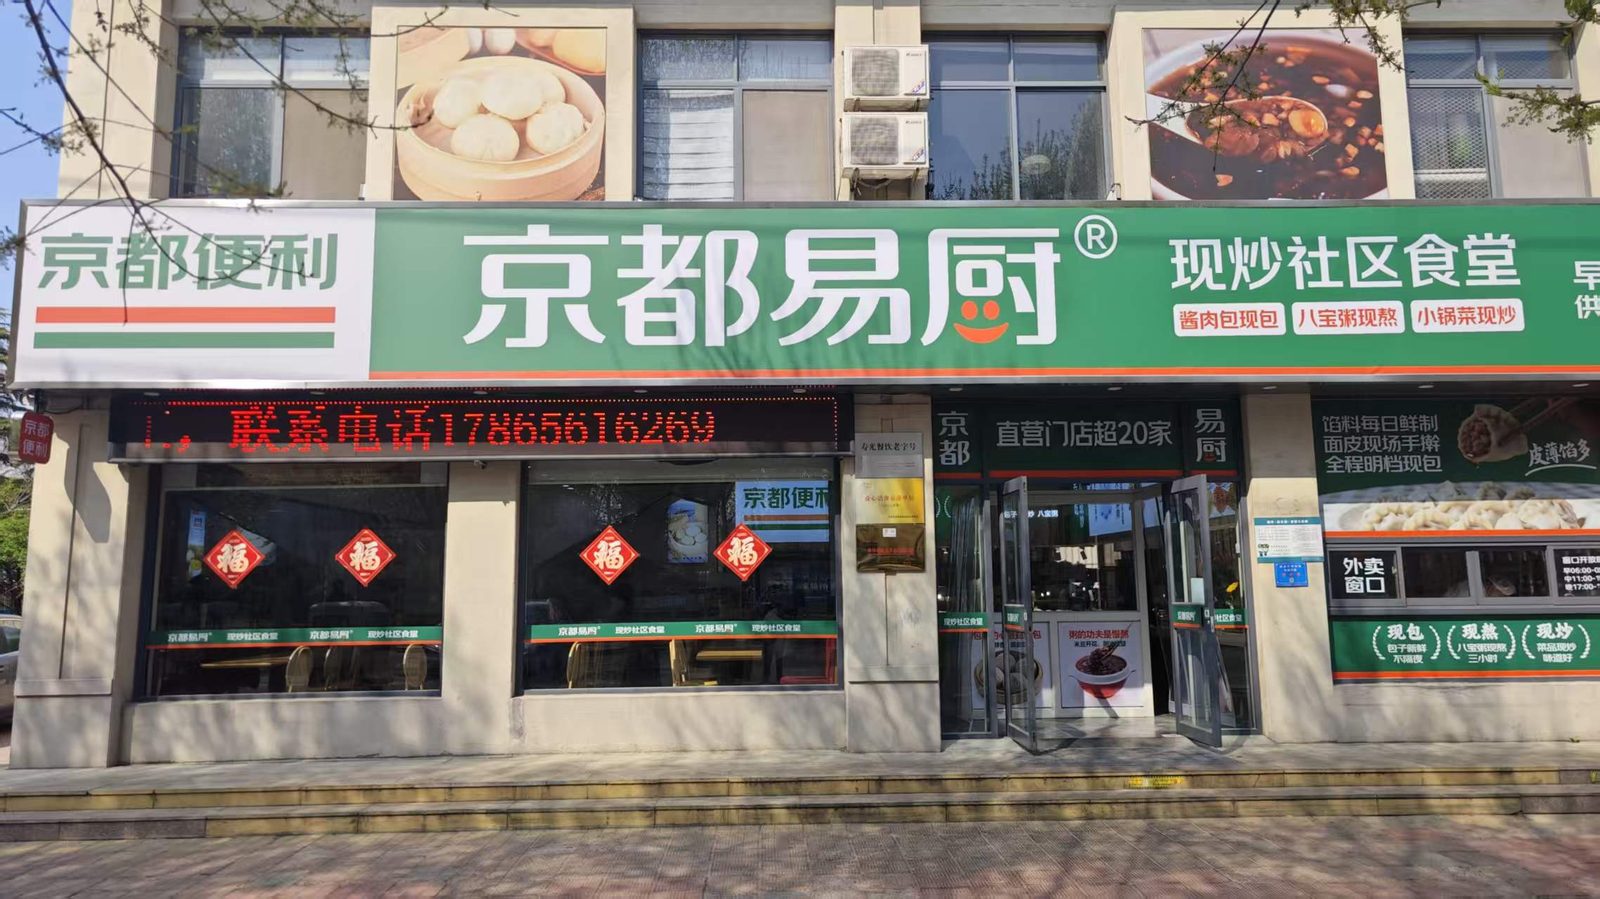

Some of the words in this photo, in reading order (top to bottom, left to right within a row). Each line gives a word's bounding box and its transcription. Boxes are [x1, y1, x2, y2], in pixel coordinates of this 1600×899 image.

[37, 232, 339, 291] 京都便利
[1168, 232, 1521, 292] 现炒社区食堂
[463, 223, 1062, 348] 京都易厨
[1573, 261, 1600, 291] 早
[1298, 308, 1399, 329] 八宝粥现熬
[1416, 305, 1517, 327] 小锅菜现炒
[1574, 294, 1600, 319] 供
[1178, 309, 1280, 331] 酱肉包现包
[995, 420, 1172, 447] 直营门店超20家
[1194, 408, 1226, 463] 易厨
[1322, 414, 1439, 433] 馅料每日鲜制
[936, 411, 969, 466] 京都
[1323, 435, 1441, 453] 面皮现场手擀
[1325, 455, 1443, 474] 全程明档现包
[1527, 438, 1592, 467] 皮薄馅多
[217, 543, 249, 573] 福
[349, 541, 381, 572] 福
[593, 540, 625, 570] 福
[727, 536, 758, 567] 福
[1343, 557, 1385, 576] 外卖
[1345, 577, 1385, 594] 窗口
[1387, 623, 1424, 640] 现包
[1461, 623, 1499, 640] 现熬
[1536, 622, 1574, 640] 现炒
[1468, 653, 1498, 663] 三小时
